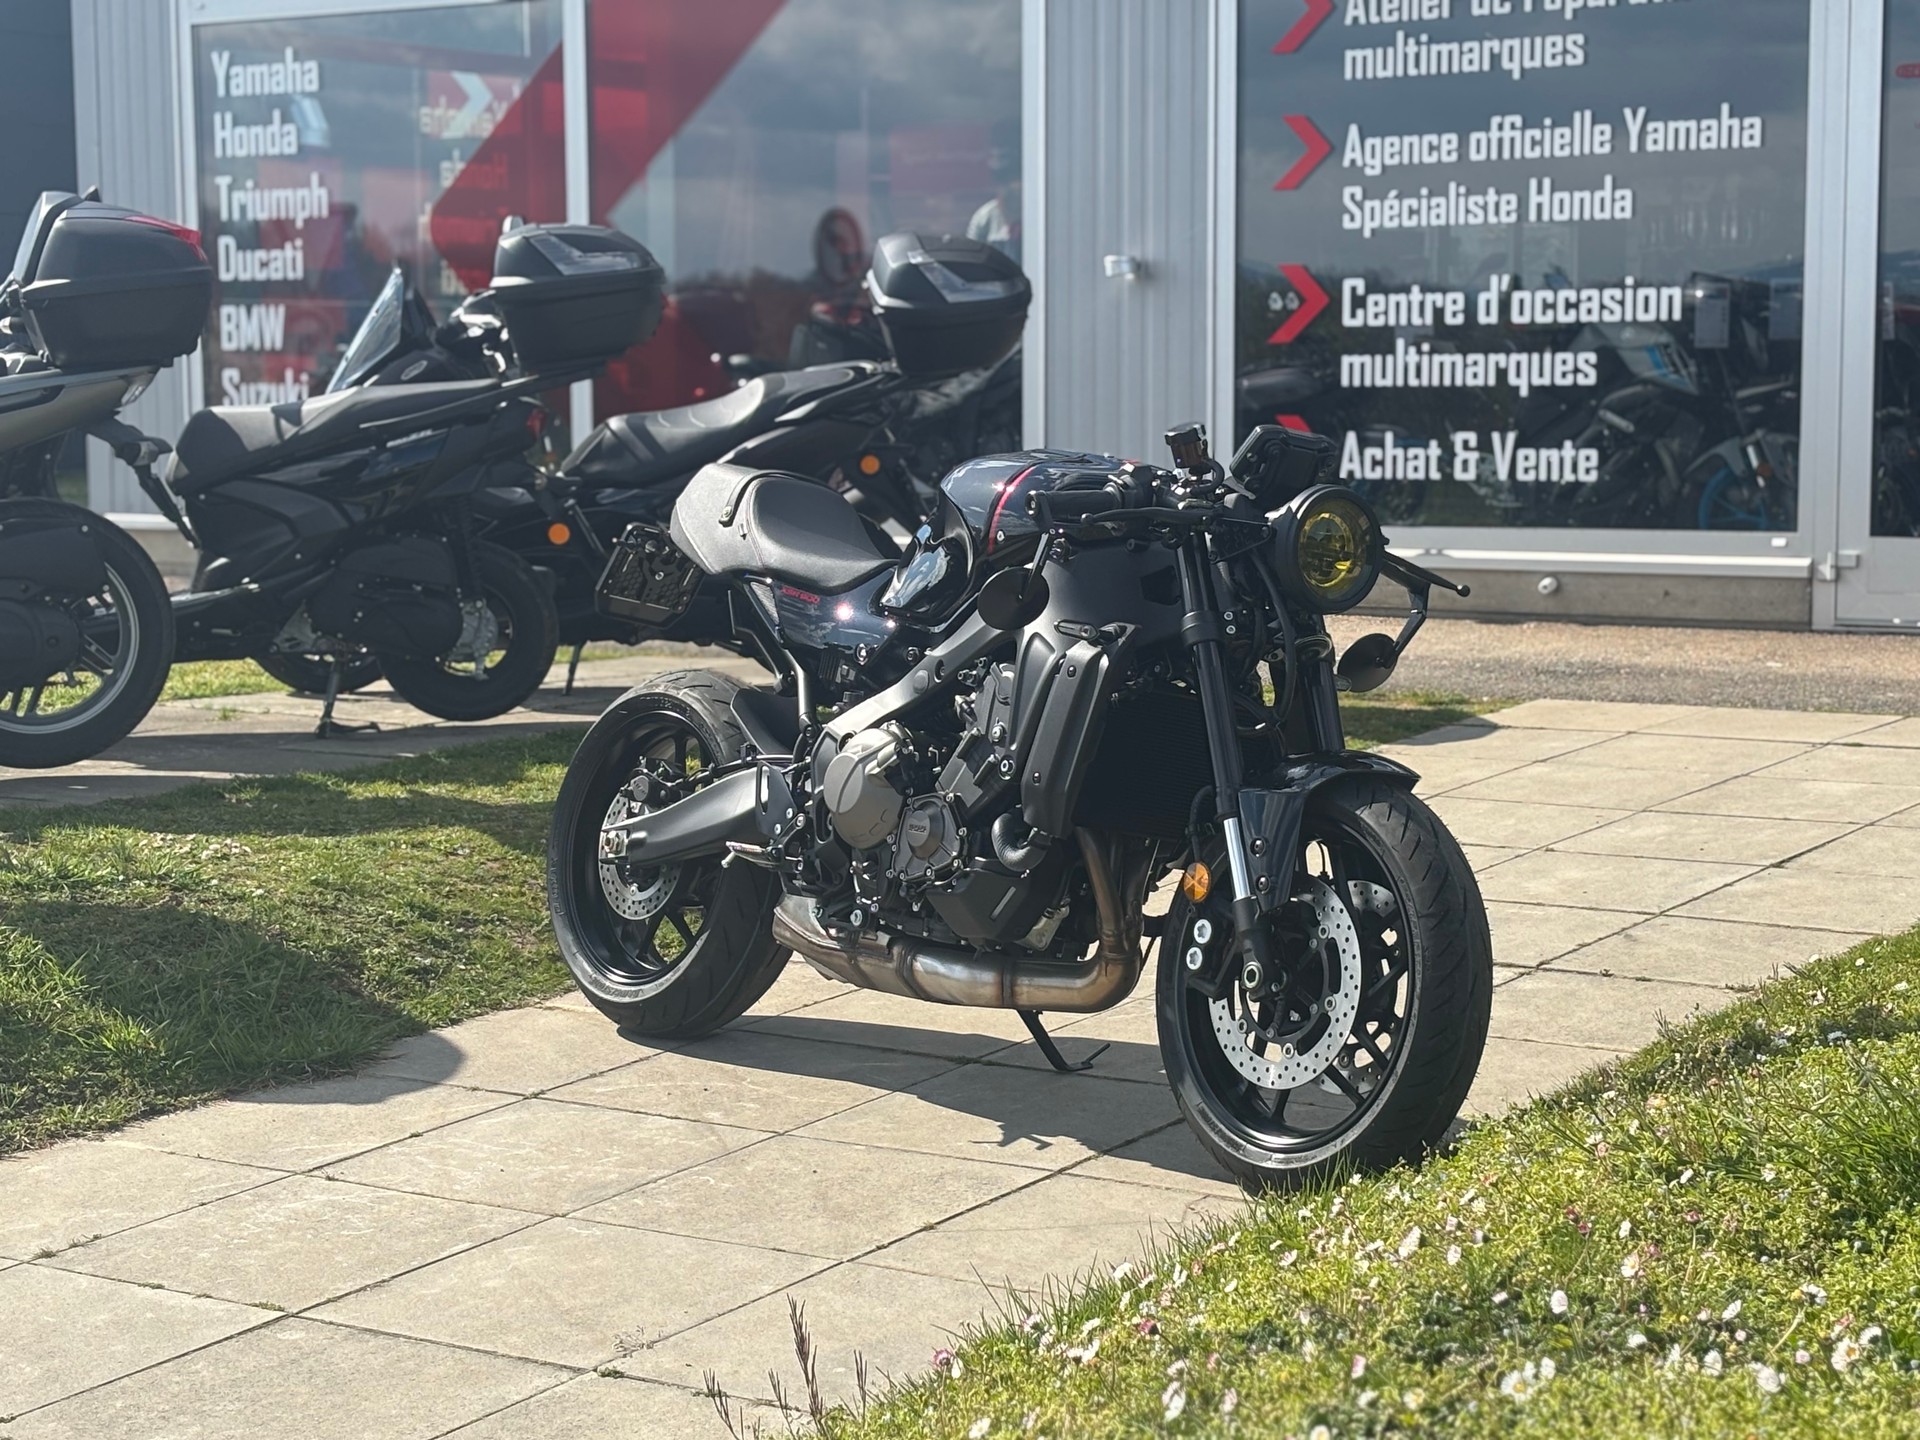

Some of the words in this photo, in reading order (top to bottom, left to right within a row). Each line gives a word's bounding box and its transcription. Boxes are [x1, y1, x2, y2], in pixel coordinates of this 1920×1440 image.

[211, 46, 319, 97] Yamaha
[1344, 31, 1585, 80] multimarques
[213, 109, 298, 158] Honda
[1343, 123, 1459, 176] Agence
[1468, 110, 1612, 161] officielle
[1623, 103, 1762, 153] Yamaha
[215, 172, 328, 228] Triumph
[1342, 181, 1518, 238] Spécialiste
[1529, 174, 1633, 222] Honda
[218, 235, 304, 282] Ducati
[1342, 277, 1465, 327] Centre
[1477, 274, 1682, 324] d'occasion
[220, 304, 285, 351] BMW
[221, 367, 310, 406] Suzuki
[1341, 338, 1598, 397] multimarques
[1340, 431, 1441, 480] Achat
[1452, 431, 1480, 481] &
[1491, 431, 1599, 483] Vente
